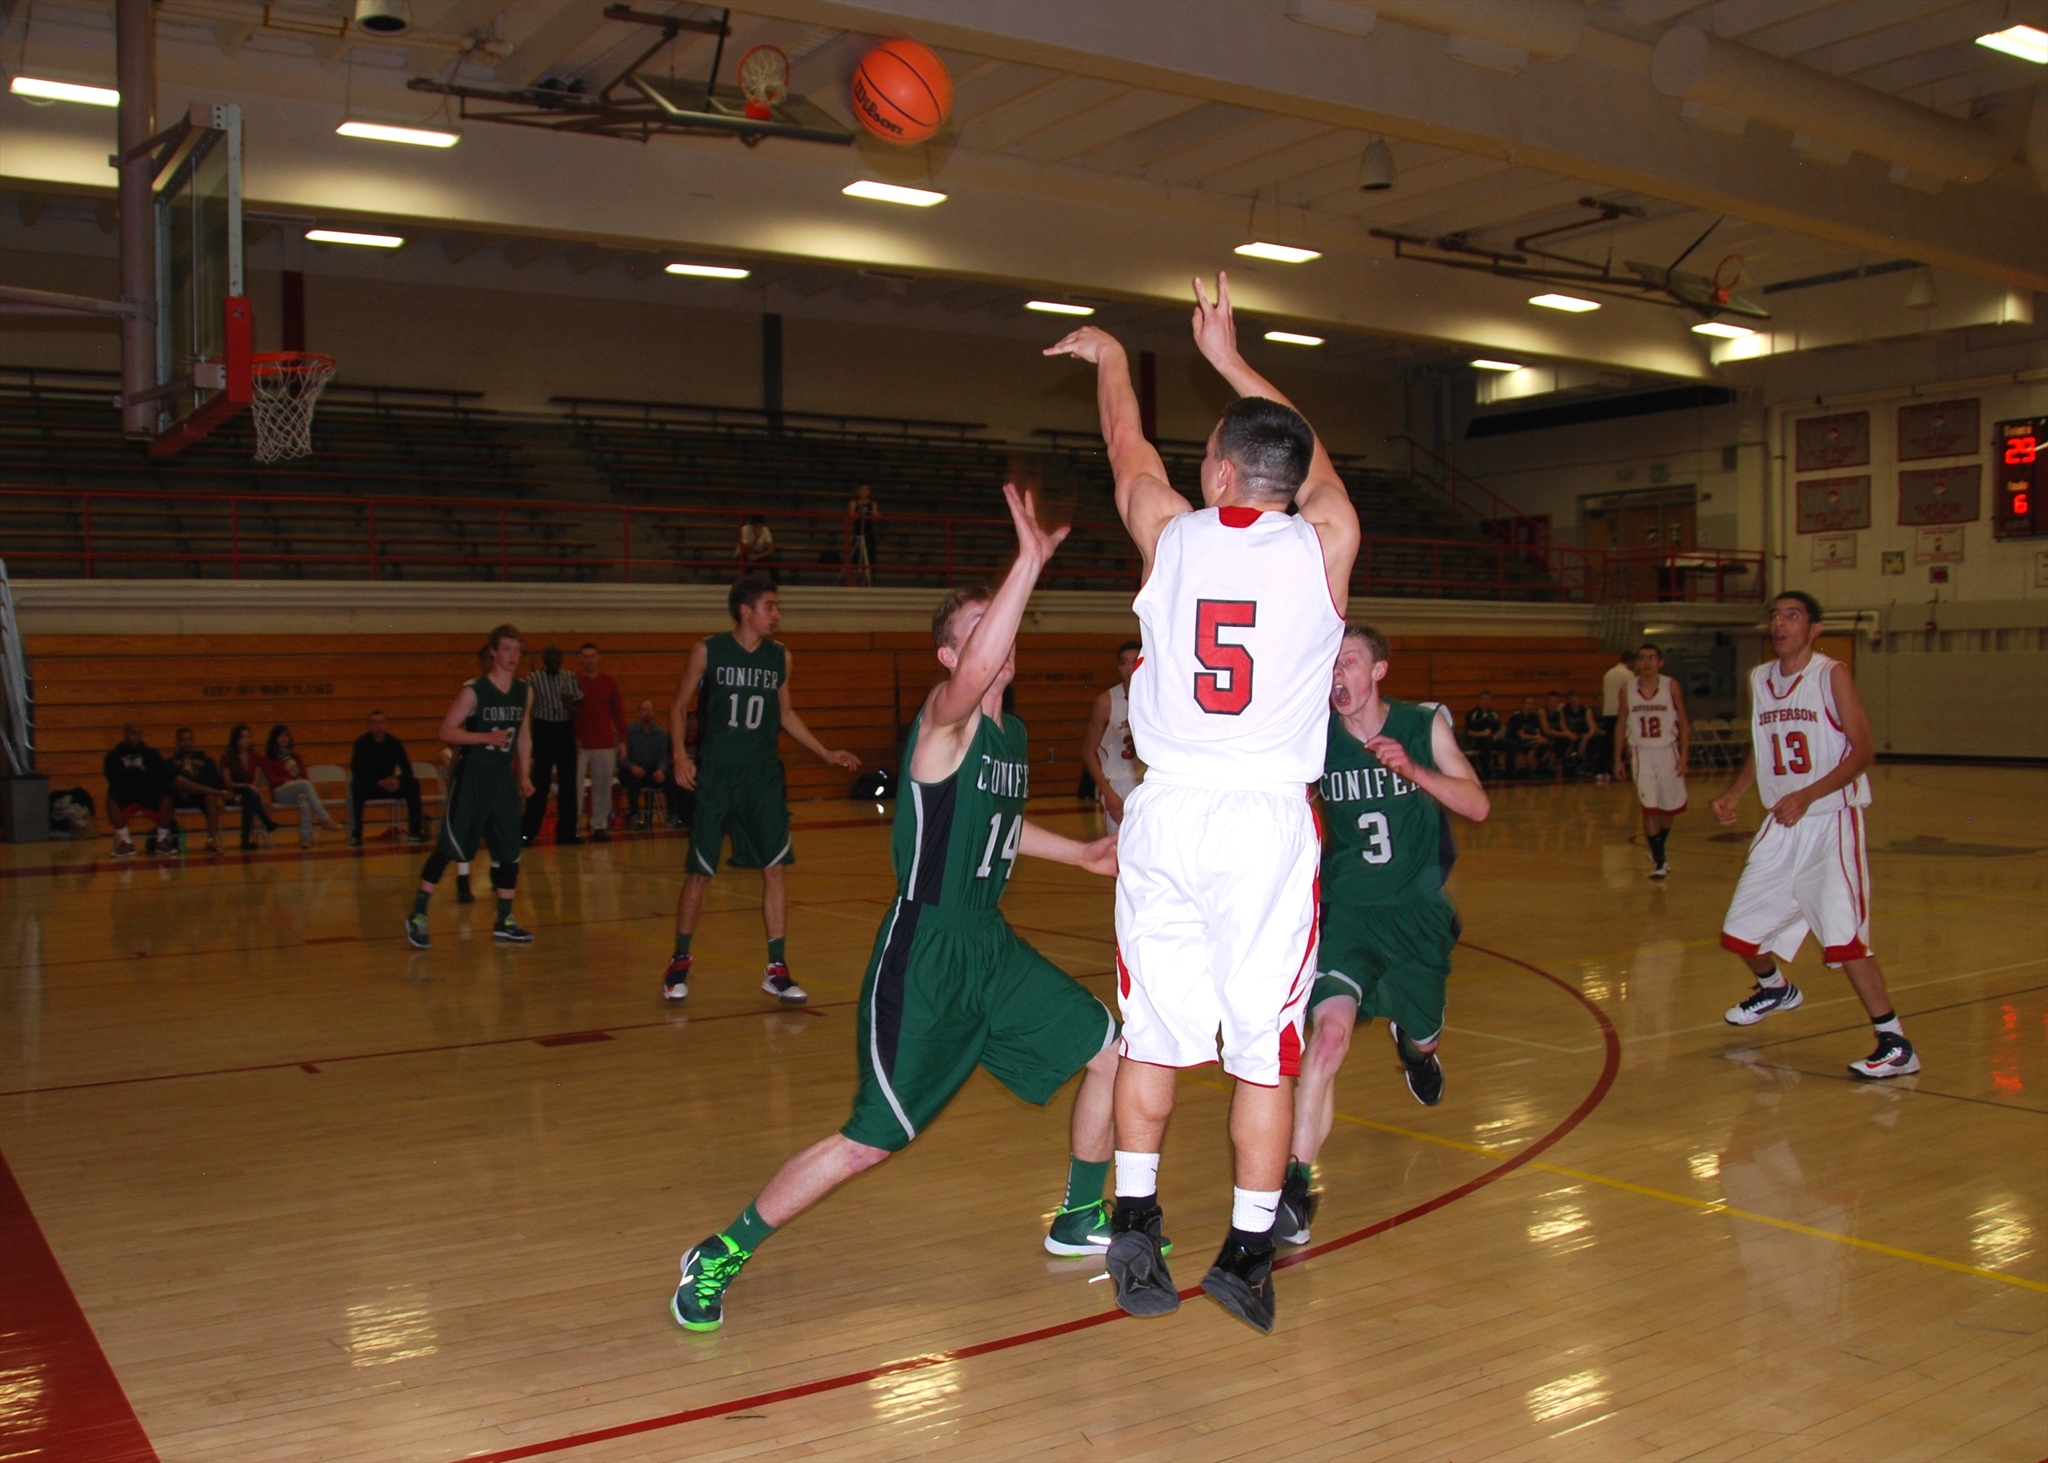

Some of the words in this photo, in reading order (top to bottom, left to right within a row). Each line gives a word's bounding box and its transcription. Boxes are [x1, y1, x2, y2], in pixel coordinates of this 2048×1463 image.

[855, 78, 904, 135] Wilson
[2005, 437, 2036, 464] 29
[2014, 494, 2028, 514] 6
[1194, 599, 1257, 716] 5
[716, 666, 778, 690] CONIFER
[483, 706, 525, 721] CONIFE
[728, 693, 765, 729] 10
[1759, 708, 1818, 726] JEFFERSON
[1640, 716, 1662, 738] 12
[1772, 731, 1812, 776] 13
[975, 812, 1022, 880] 14
[1358, 811, 1393, 864] 3
